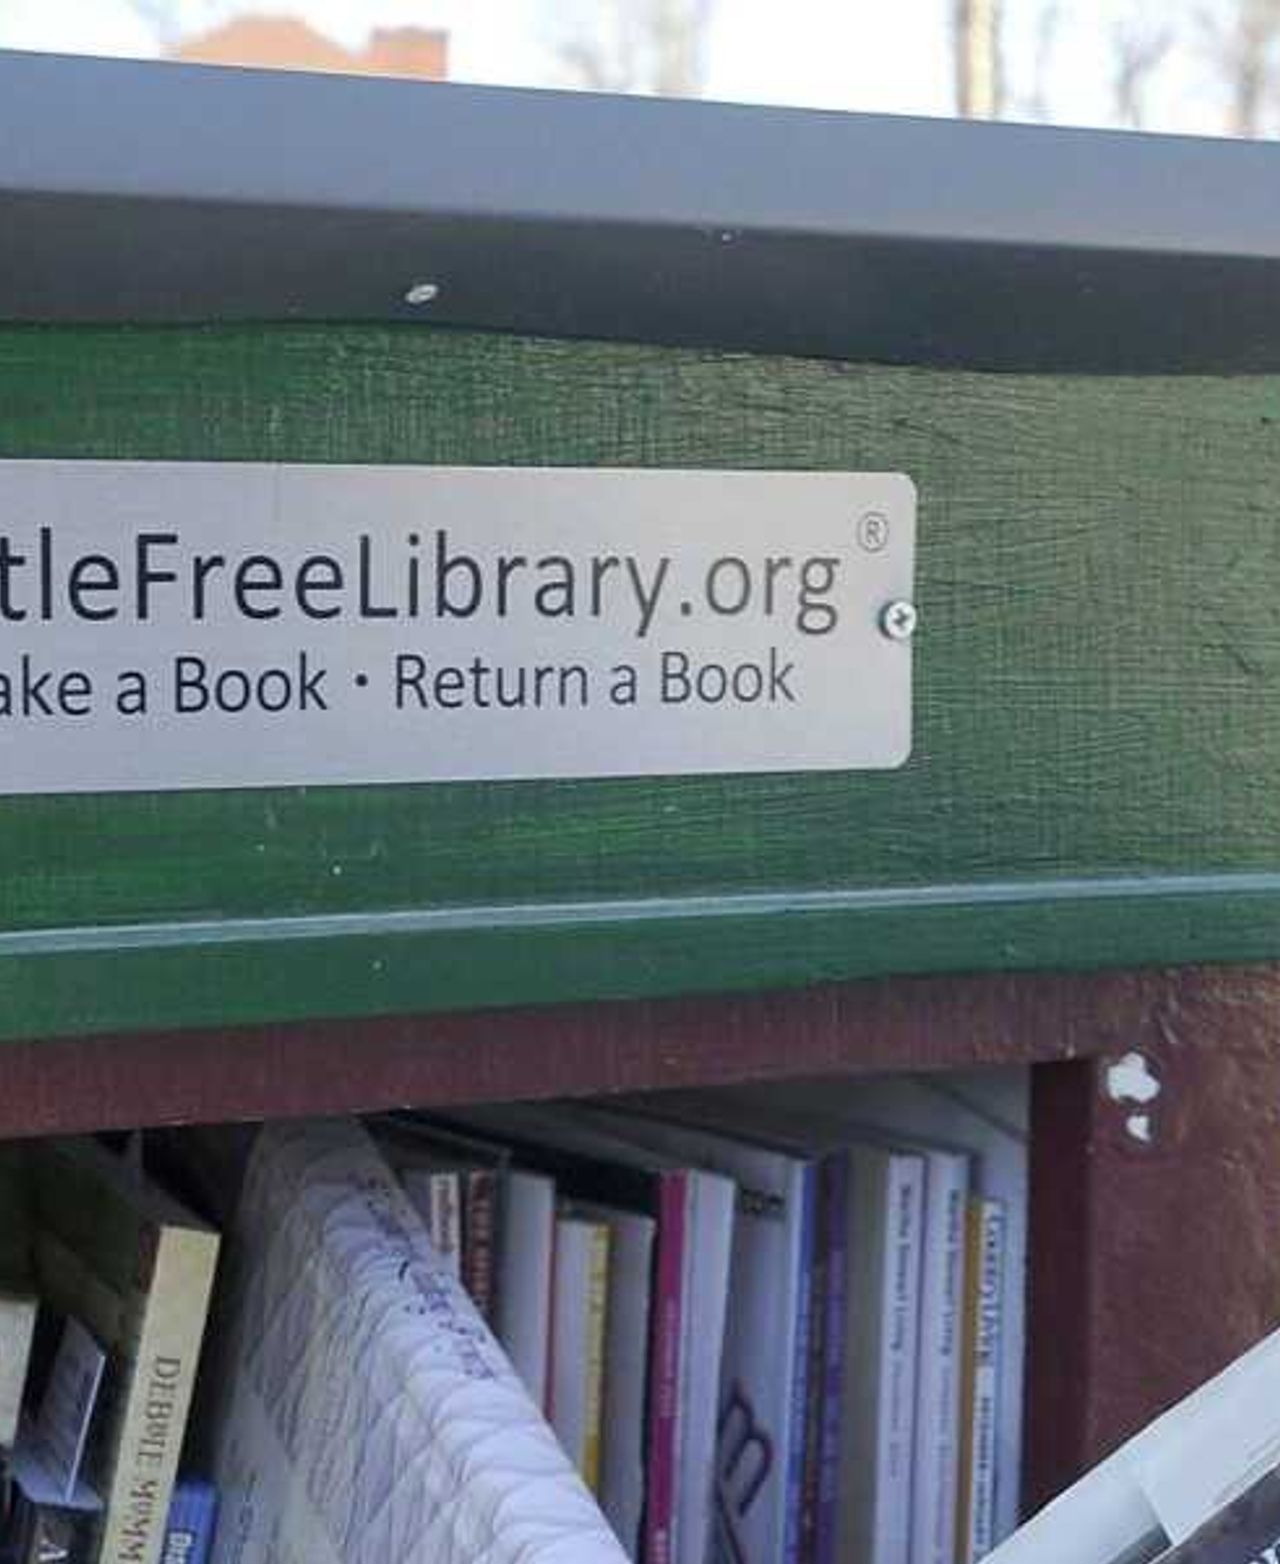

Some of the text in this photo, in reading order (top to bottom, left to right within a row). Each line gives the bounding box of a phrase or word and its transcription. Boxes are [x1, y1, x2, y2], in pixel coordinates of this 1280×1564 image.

[116, 672, 148, 716] a
[175, 651, 328, 713] Book
[396, 653, 588, 710] Return
[609, 663, 638, 704] a
[660, 646, 796, 705] Book
[38, 1537, 69, 1562] A
